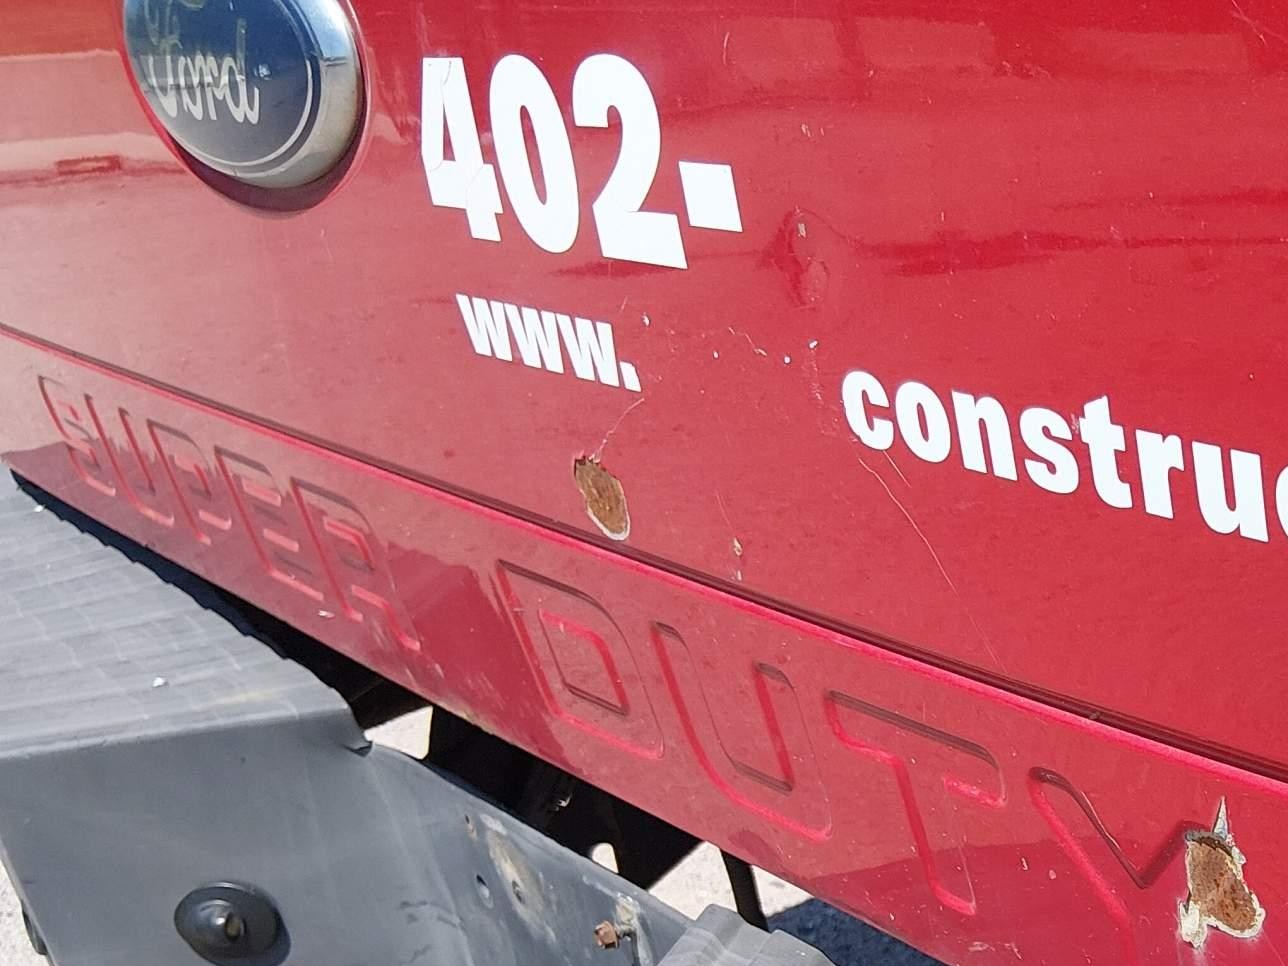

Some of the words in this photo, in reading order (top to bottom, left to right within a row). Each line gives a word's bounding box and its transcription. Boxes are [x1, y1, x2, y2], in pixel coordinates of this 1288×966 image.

[140, 0, 260, 124] Ford
[420, 53, 743, 270] 402-
[455, 293, 642, 393] www.
[37, 365, 422, 652] SUPER
